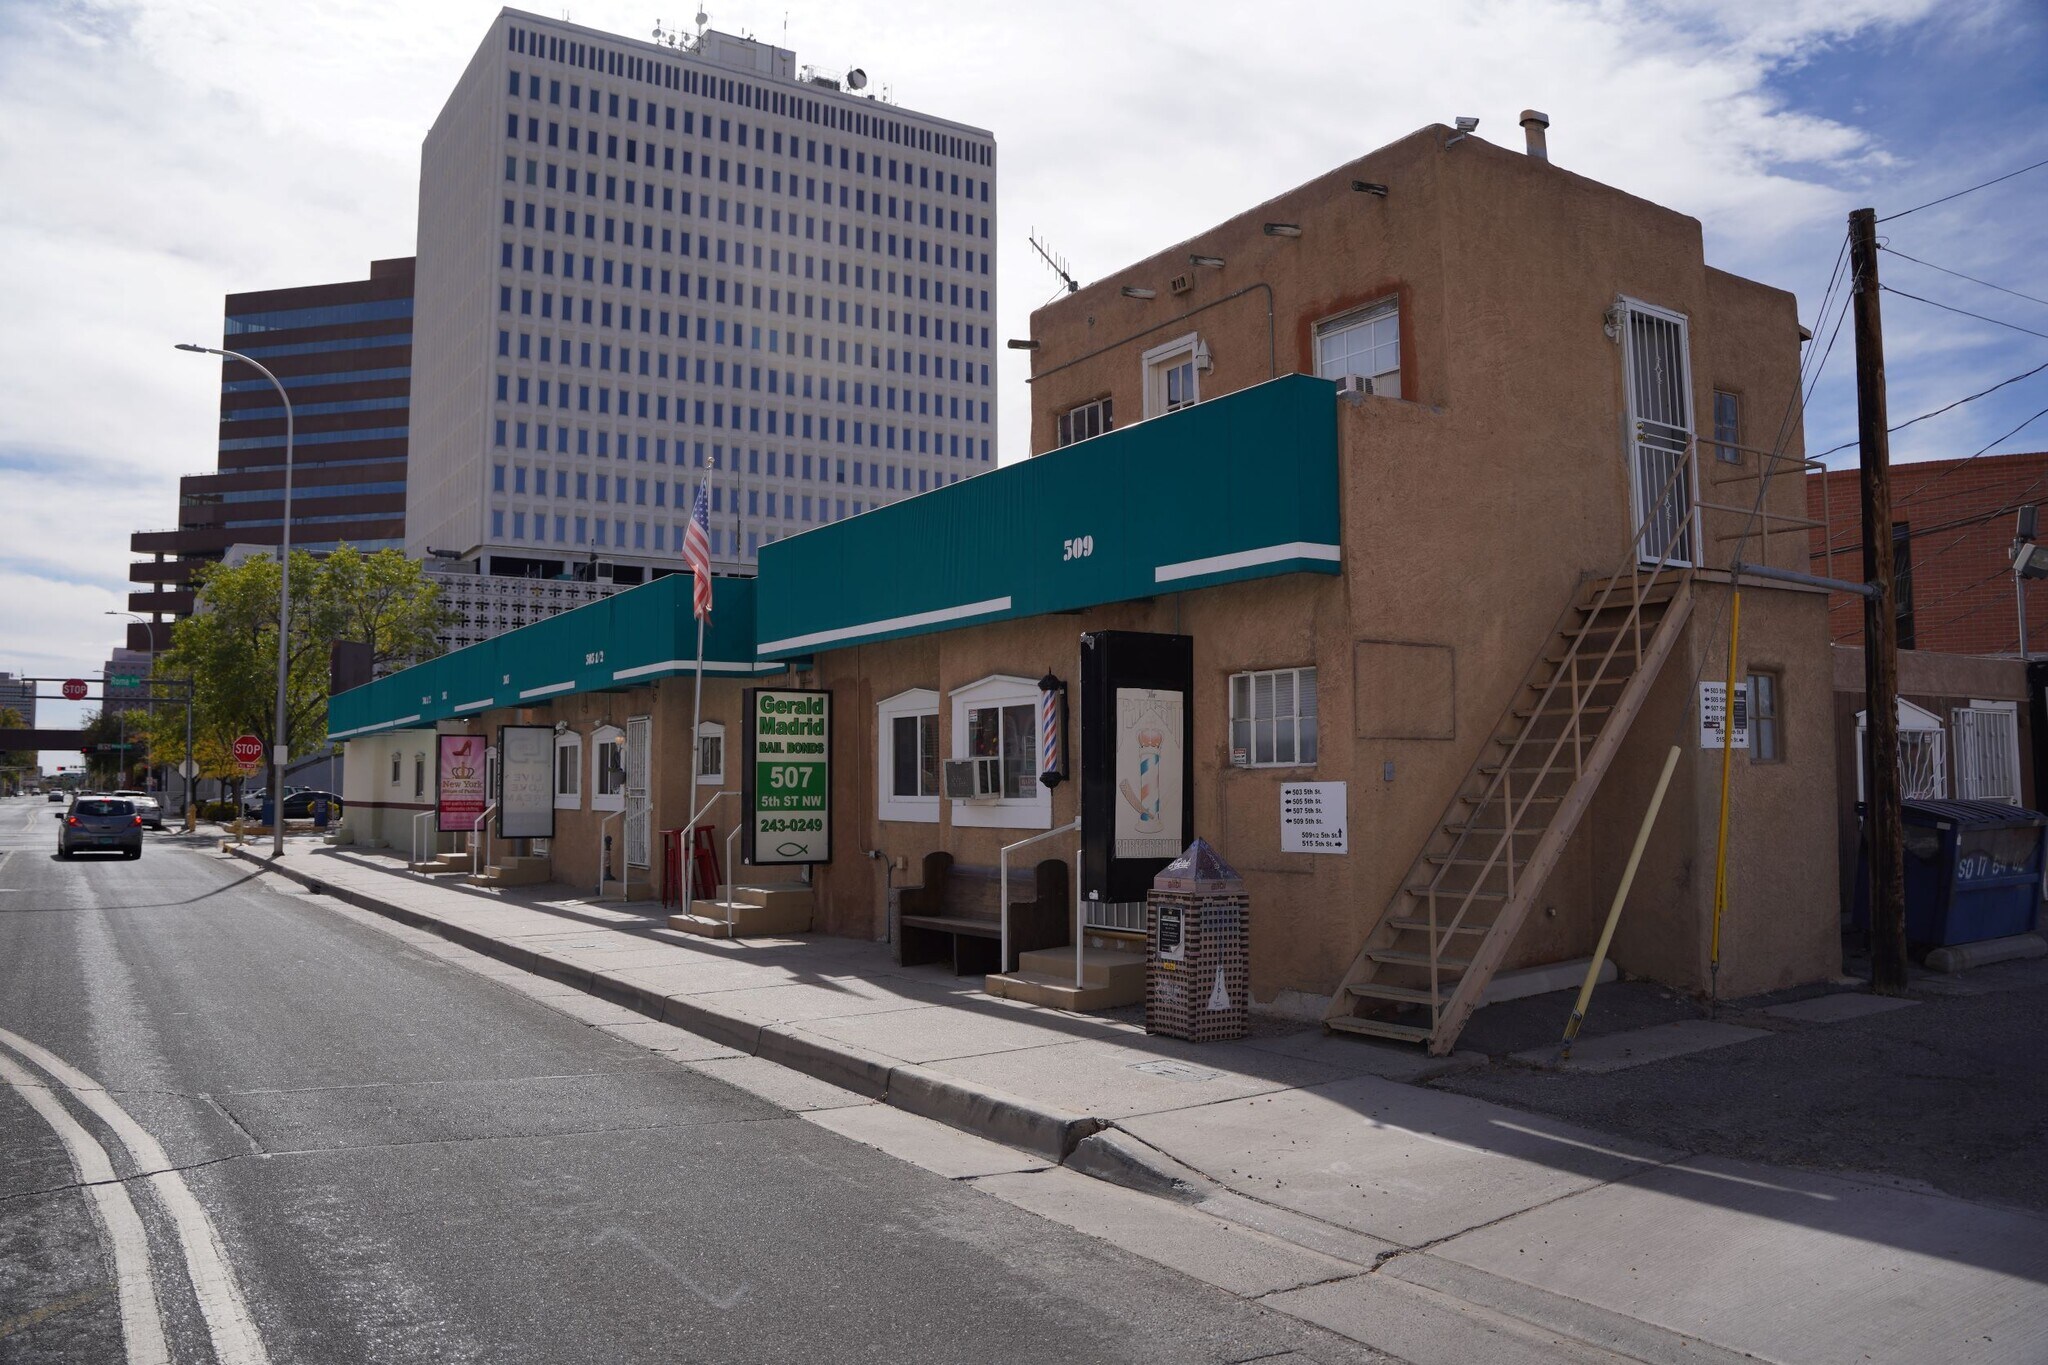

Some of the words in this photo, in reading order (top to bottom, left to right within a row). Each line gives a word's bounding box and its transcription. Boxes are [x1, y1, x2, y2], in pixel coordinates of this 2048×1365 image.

[1063, 535, 1094, 561] 509
[111, 677, 129, 686] Roma
[63, 685, 87, 694] STOP
[760, 695, 824, 715] Gerald
[759, 717, 824, 736] Madrid
[235, 743, 260, 755] STOP
[759, 742, 784, 753] BAIL
[787, 742, 824, 754] BONDS
[770, 766, 813, 788] 507
[761, 795, 780, 807] 5th
[783, 795, 798, 807] ST
[802, 795, 821, 807] NW
[760, 818, 823, 832] 243-0249
